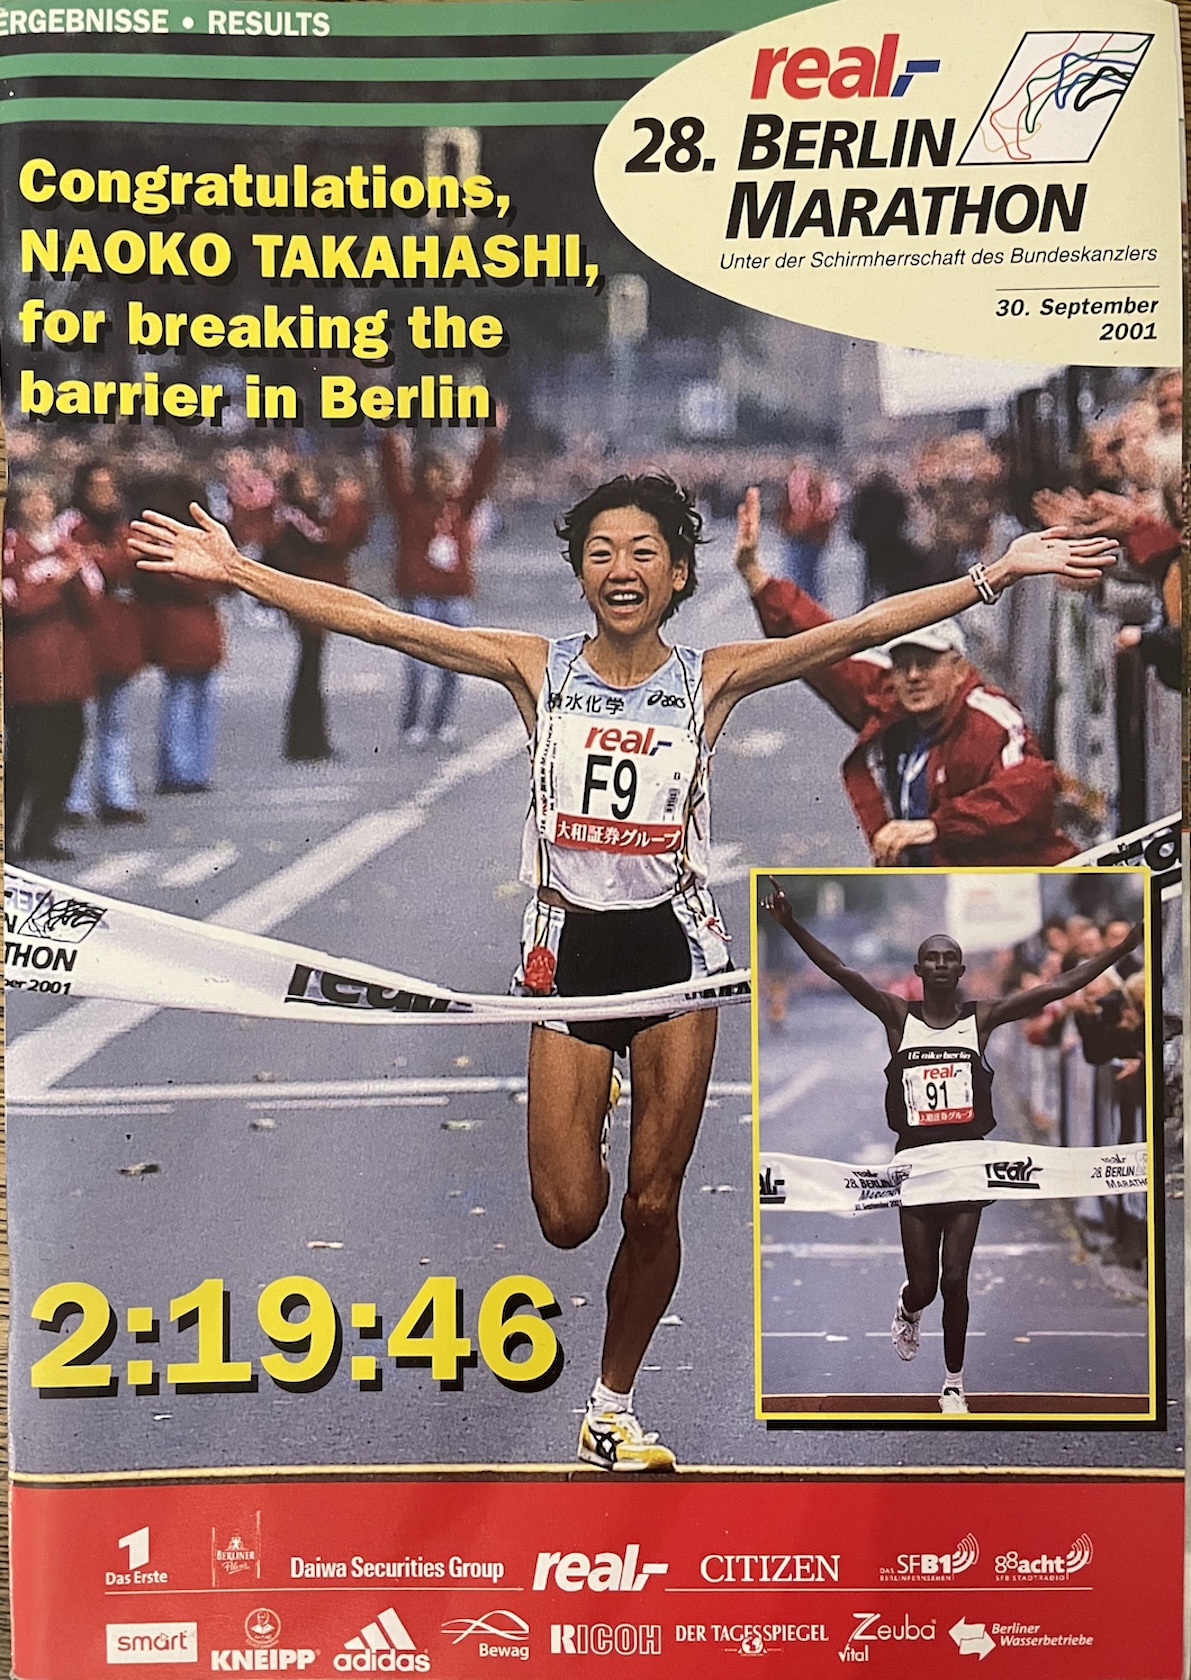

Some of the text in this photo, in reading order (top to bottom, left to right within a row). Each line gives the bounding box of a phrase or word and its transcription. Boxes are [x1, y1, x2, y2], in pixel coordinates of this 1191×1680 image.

[209, 11, 329, 36] RESULTS
[625, 113, 956, 172] 28. BERLIN
[19, 159, 509, 215] Congratulations,
[726, 181, 1087, 238] MARATHON
[21, 229, 598, 285] NAOKO TAKAHASHI,
[721, 245, 1157, 269] Unter der Schirmherrschaft des Bundeskanzlers
[996, 297, 1158, 317] 30. September
[18, 299, 502, 359] for breaking the
[1100, 323, 1156, 340] 2001
[20, 370, 489, 420] barrier in Berlin
[580, 753, 637, 820] F9
[27, 979, 71, 995] 2001
[926, 1080, 948, 1110] 91
[30, 1274, 558, 1387] 2:19:46
[216, 1549, 256, 1562] BERLINER
[994, 1551, 1065, 1575] 88acht
[106, 1571, 167, 1585] Das Erste
[291, 1557, 503, 1583] Daiwa Securities Group
[701, 1555, 840, 1582] CITIZEN
[549, 1622, 664, 1656] RICOH
[676, 1625, 828, 1643] DER TAGESSPIEGEL
[849, 1613, 937, 1641] Zeuba
[992, 1623, 1040, 1633] Berliner
[117, 1631, 188, 1651] smart
[480, 1643, 528, 1660] Bewag
[998, 1633, 1095, 1648] Wasserbetriebe
[211, 1649, 315, 1671] KNEIPP
[332, 1649, 432, 1674] adidas
